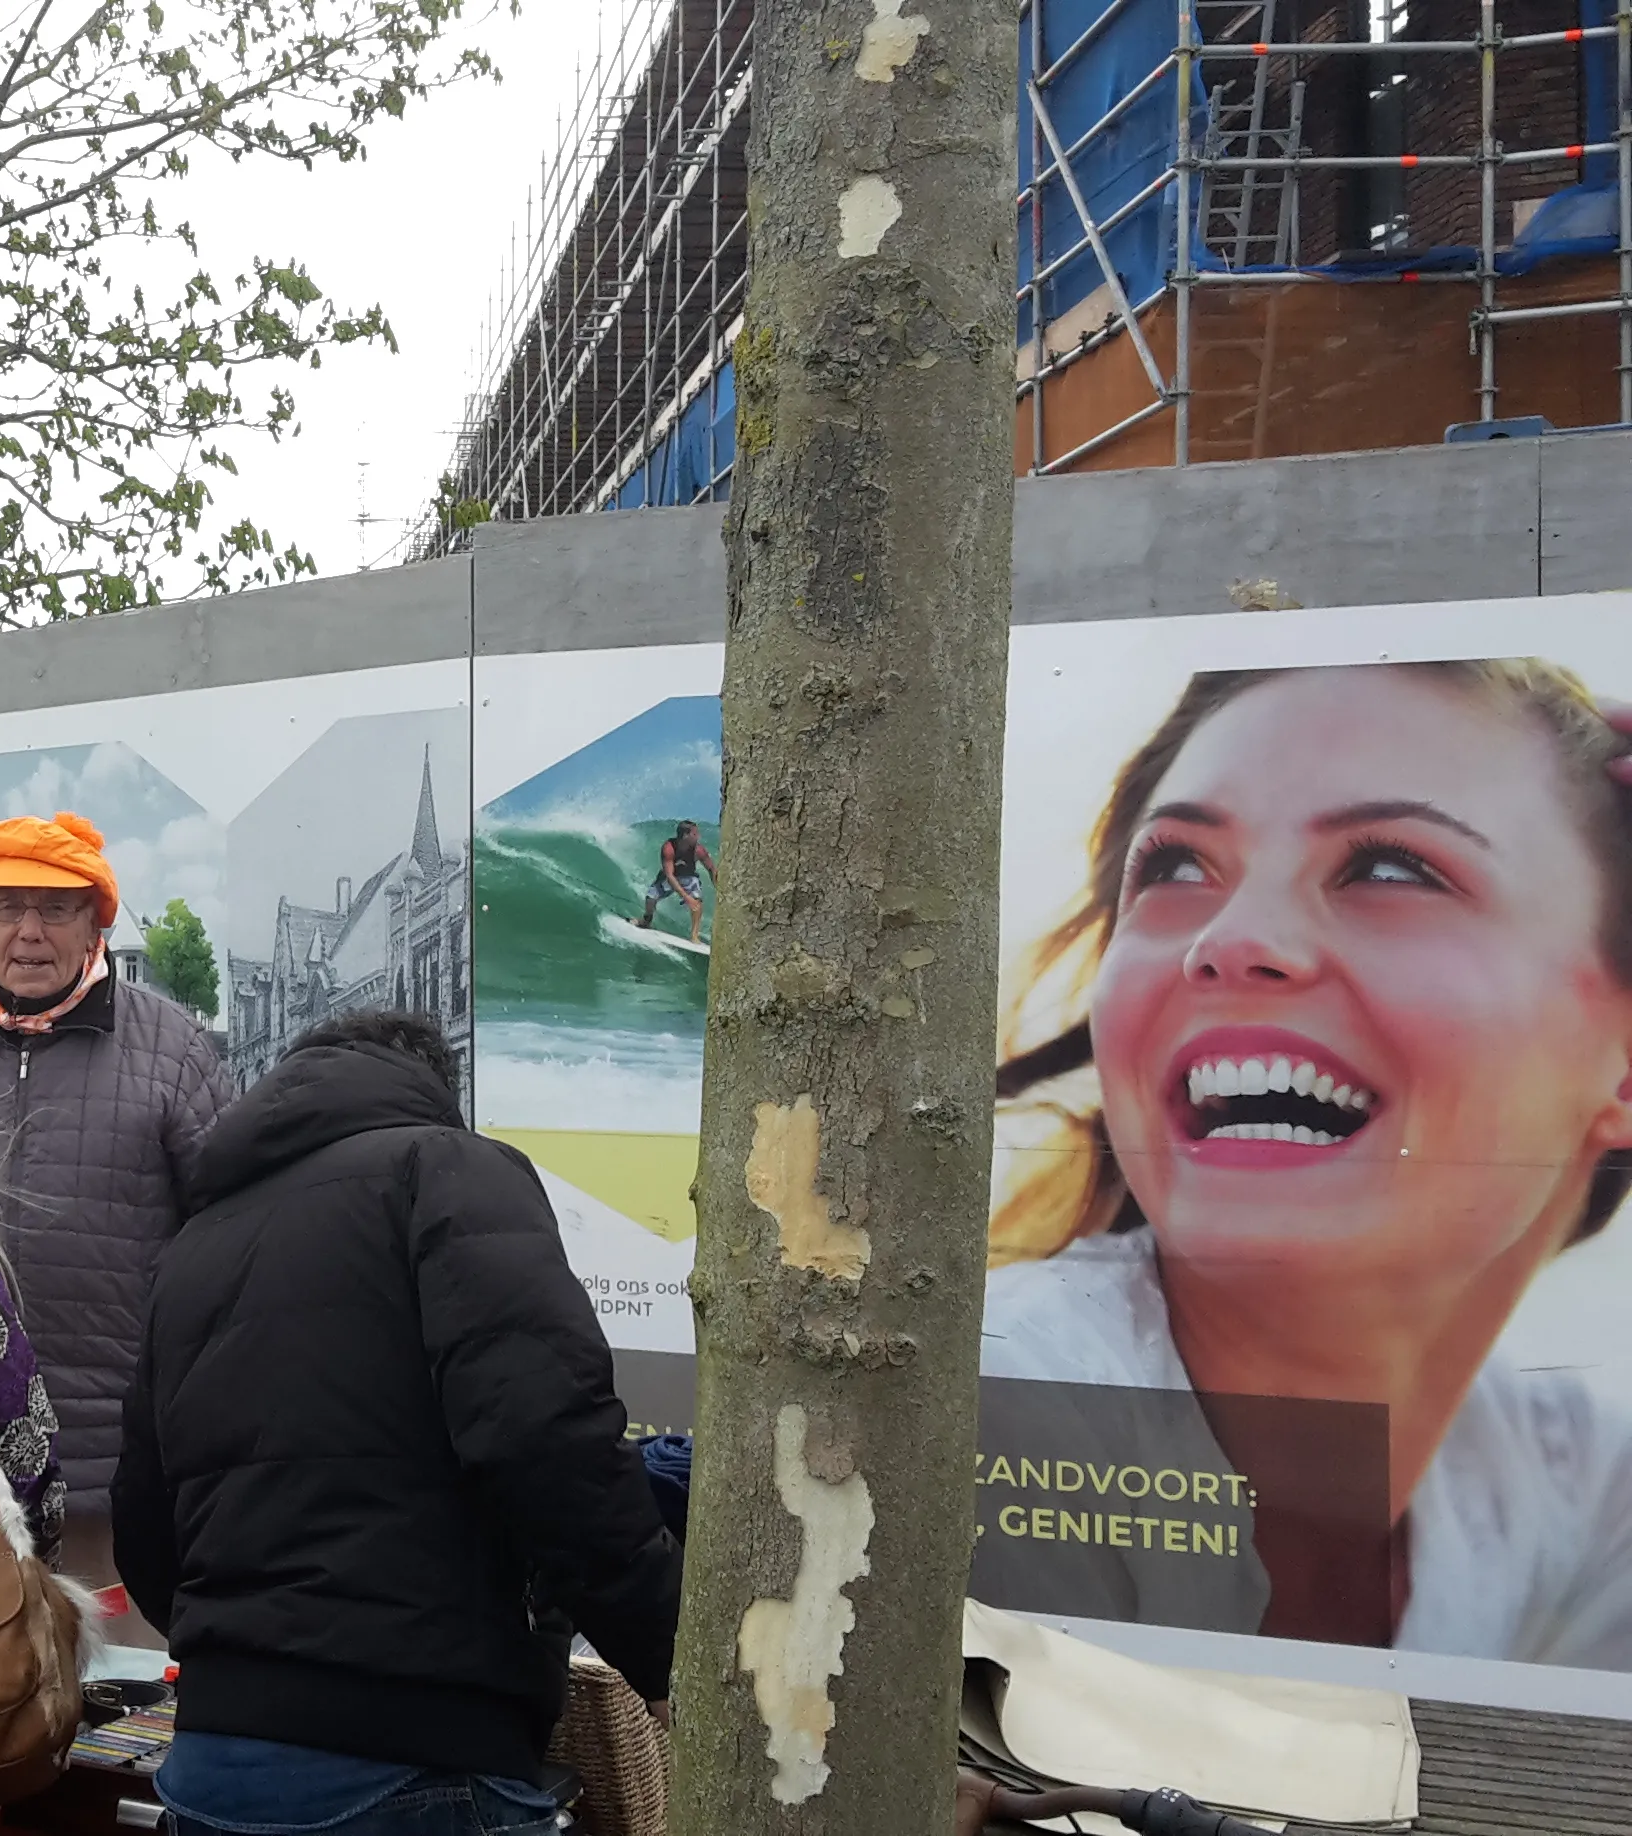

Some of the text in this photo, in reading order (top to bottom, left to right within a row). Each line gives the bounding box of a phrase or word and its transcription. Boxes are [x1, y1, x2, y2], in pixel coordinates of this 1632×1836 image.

[578, 1274, 689, 1296] olg ons ook
[998, 1504, 1239, 1557] GENIETEN!
